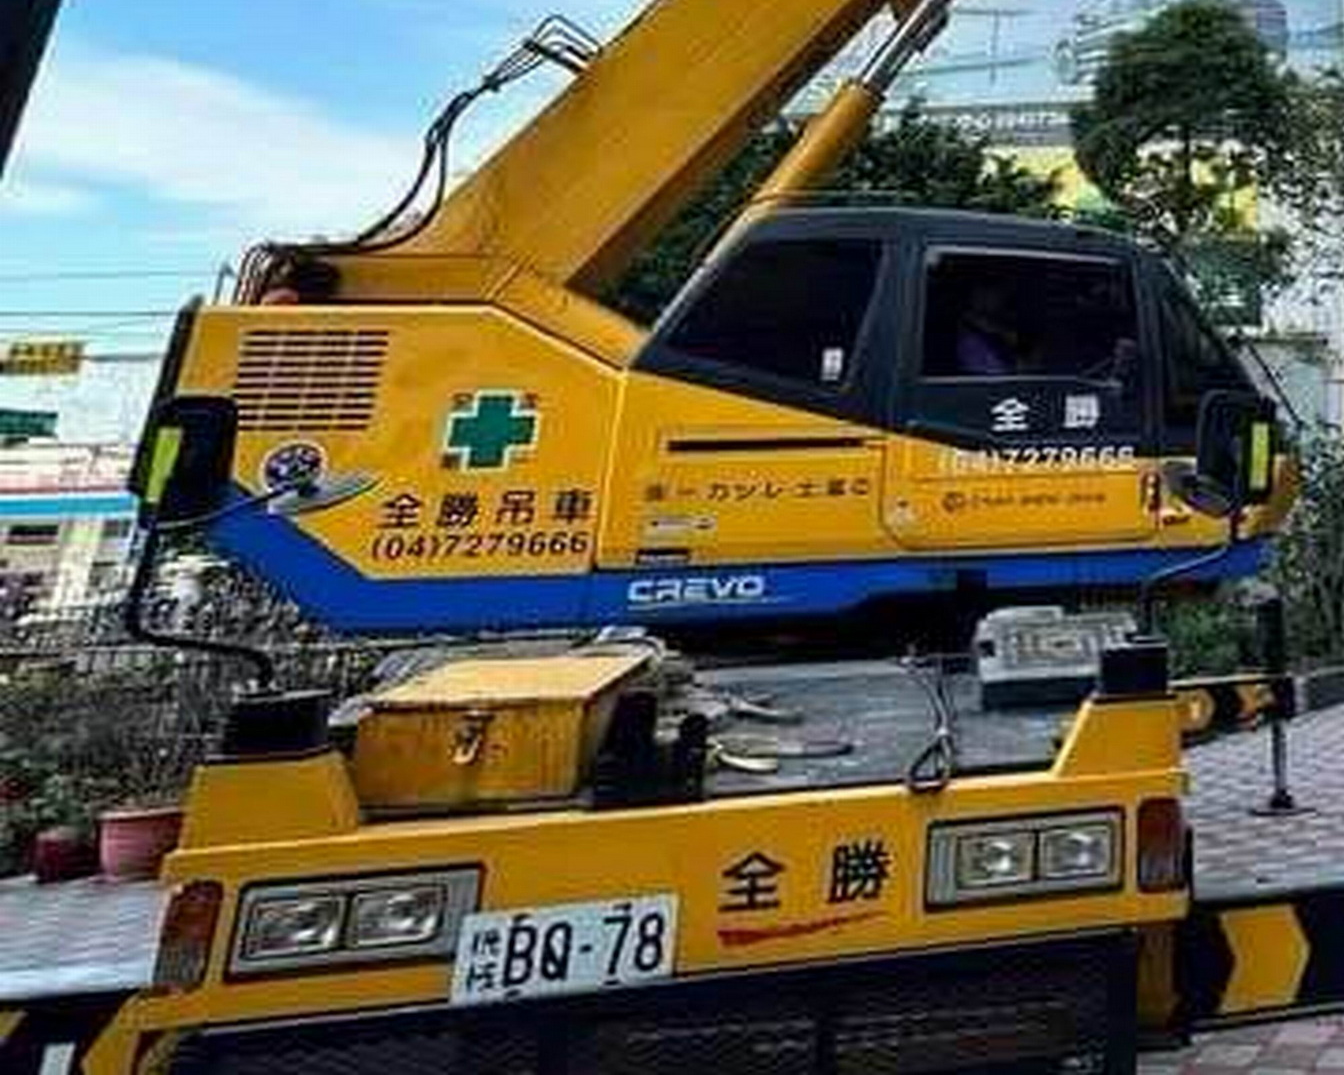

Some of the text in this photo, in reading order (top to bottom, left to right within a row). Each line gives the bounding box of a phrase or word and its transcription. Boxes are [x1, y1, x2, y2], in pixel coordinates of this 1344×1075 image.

[378, 488, 596, 527] 全勝吊車
[372, 531, 588, 562] (04)7279666
[628, 576, 765, 601] CREVO
[718, 841, 893, 912] 全勝
